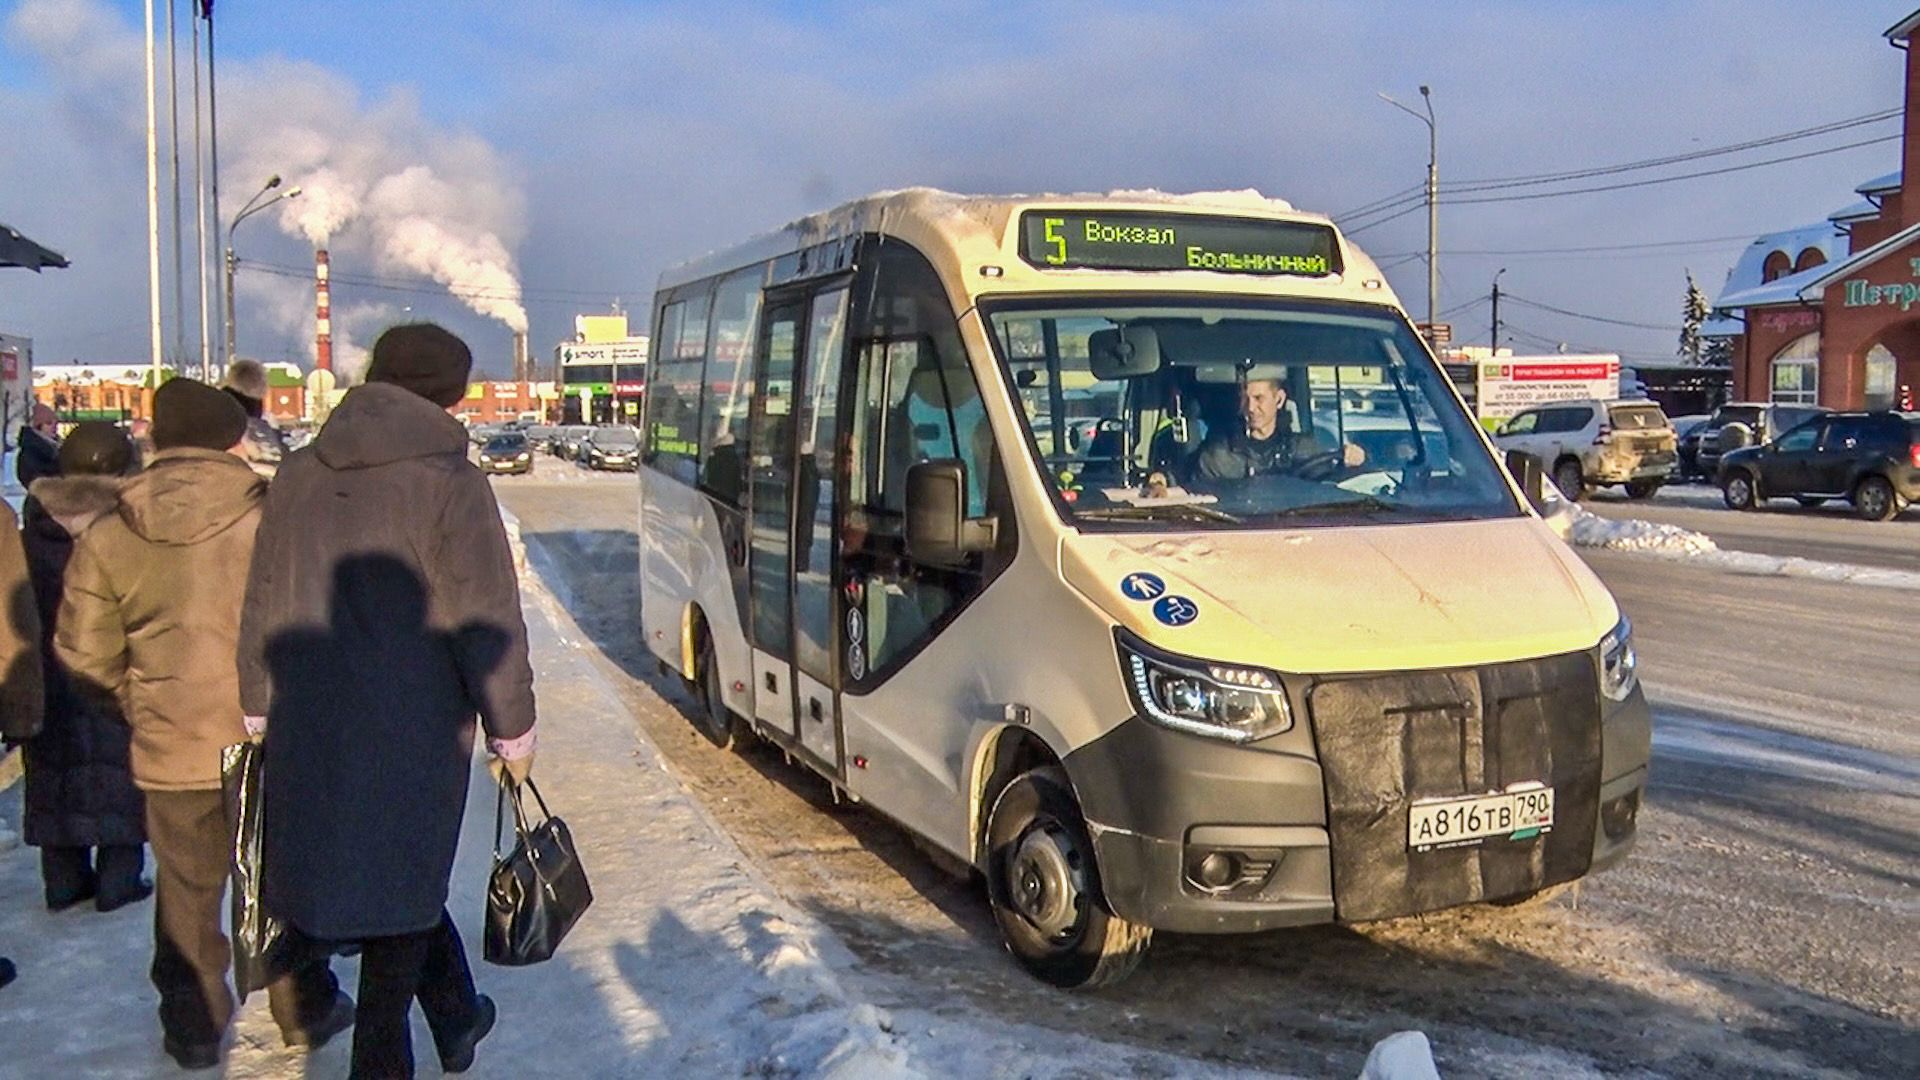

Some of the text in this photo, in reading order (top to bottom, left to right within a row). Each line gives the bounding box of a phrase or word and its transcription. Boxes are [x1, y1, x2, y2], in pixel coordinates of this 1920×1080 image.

[1044, 217, 1067, 265] 5
[1084, 219, 1175, 245] Вокзал
[1187, 245, 1327, 273] Больничный
[1844, 279, 1920, 311] Петр
[1419, 792, 1549, 840] А816ТВ 790
